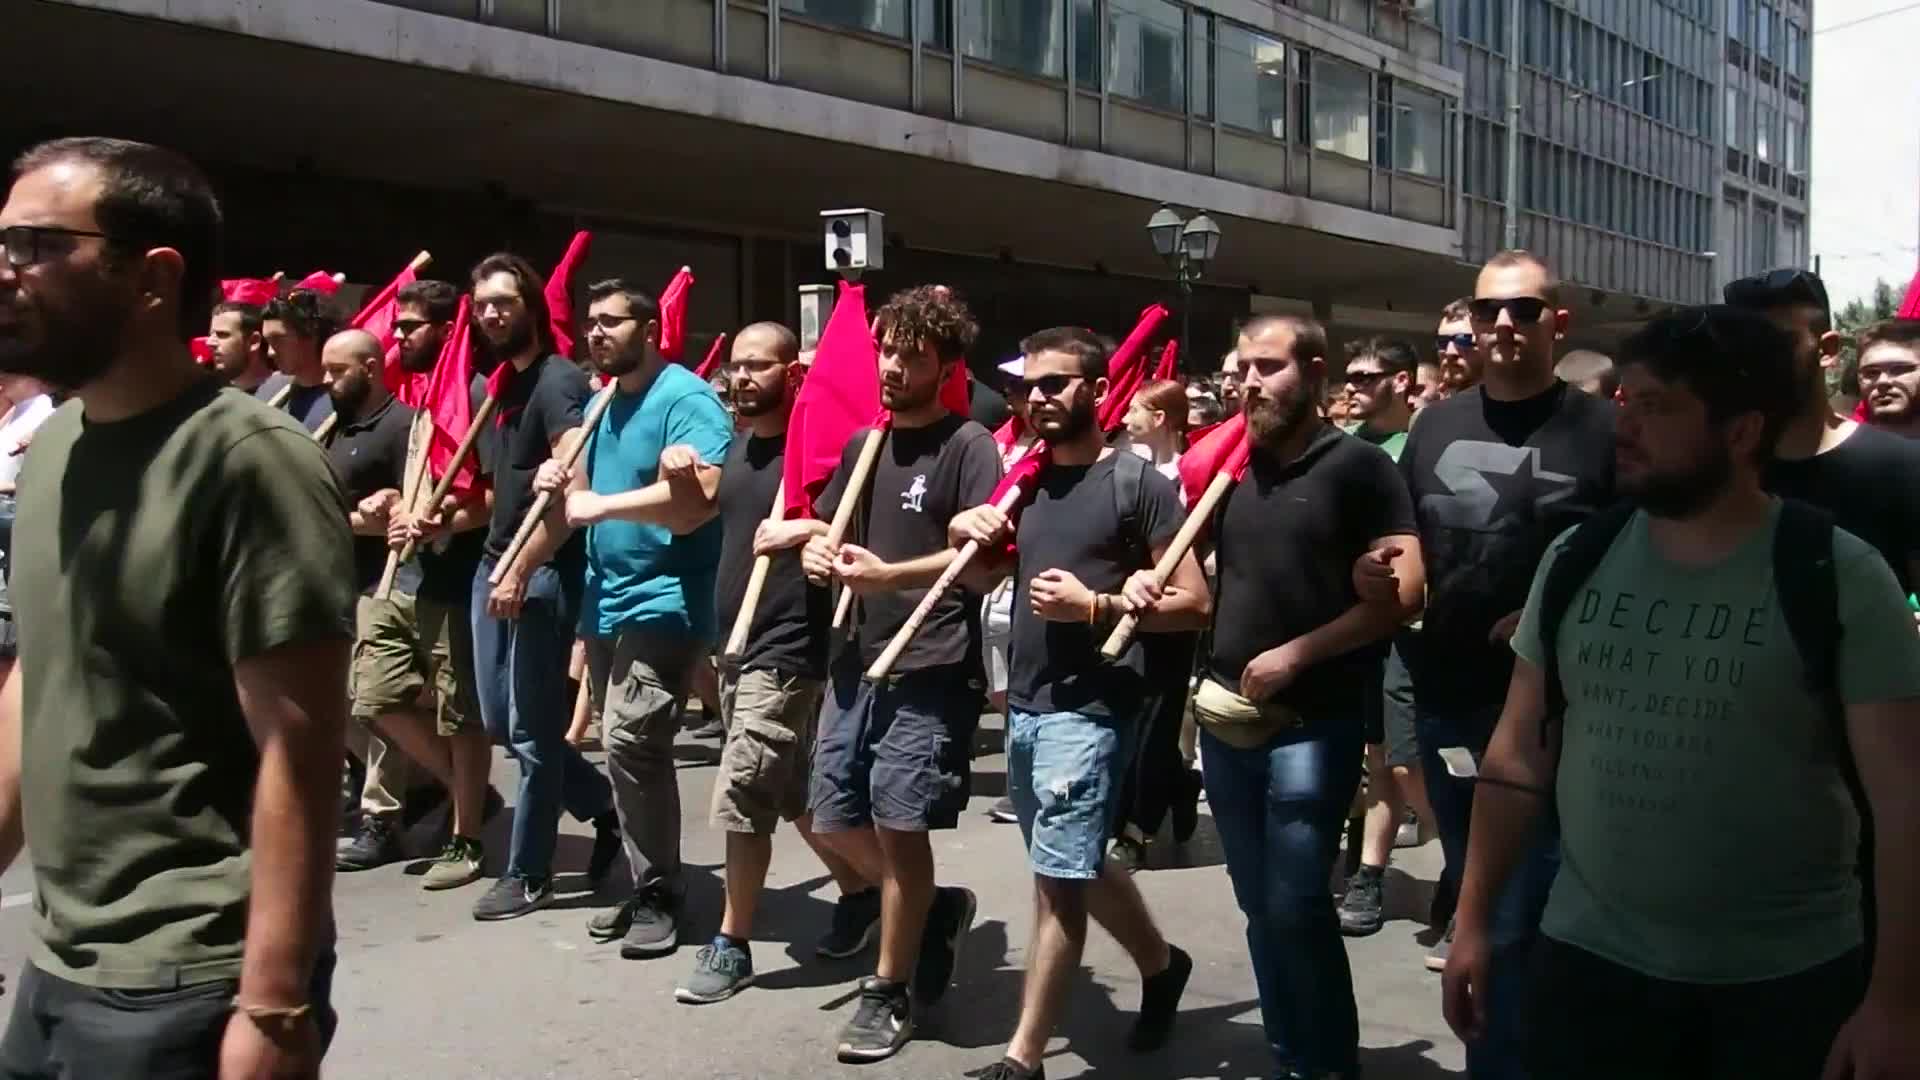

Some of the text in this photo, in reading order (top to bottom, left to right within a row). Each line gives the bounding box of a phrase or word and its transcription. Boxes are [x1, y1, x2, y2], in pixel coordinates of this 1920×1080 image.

[1578, 588, 1766, 647] DECIDE
[1578, 639, 1745, 688] WHAT YOU
[1644, 692, 1736, 721] DECIDE
